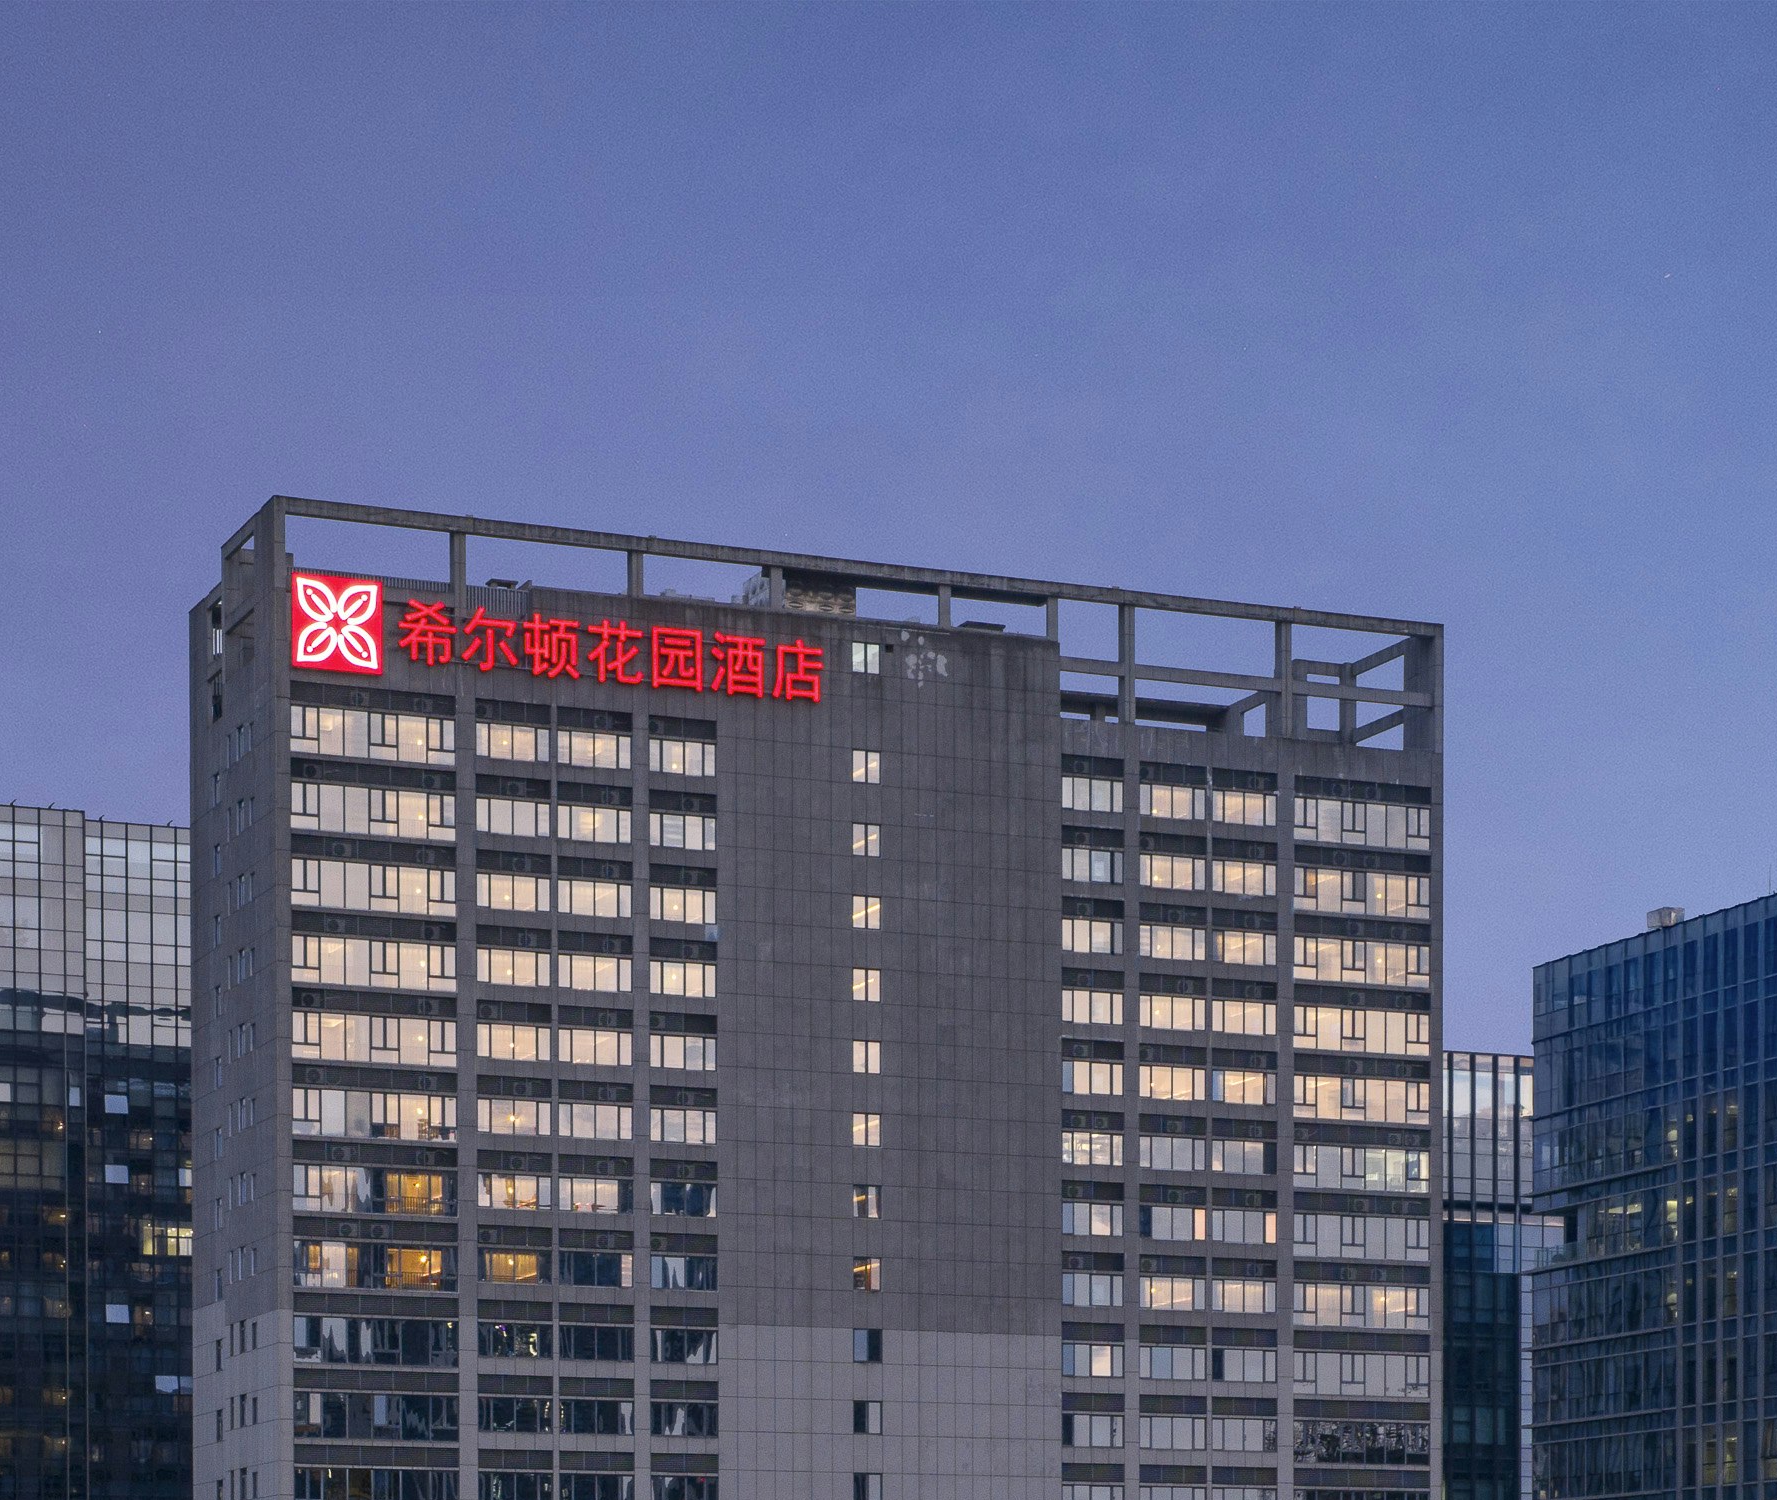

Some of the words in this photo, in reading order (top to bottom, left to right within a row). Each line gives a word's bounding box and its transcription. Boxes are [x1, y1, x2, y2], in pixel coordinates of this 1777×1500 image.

[398, 600, 823, 702] 希尔顿花园酒店
